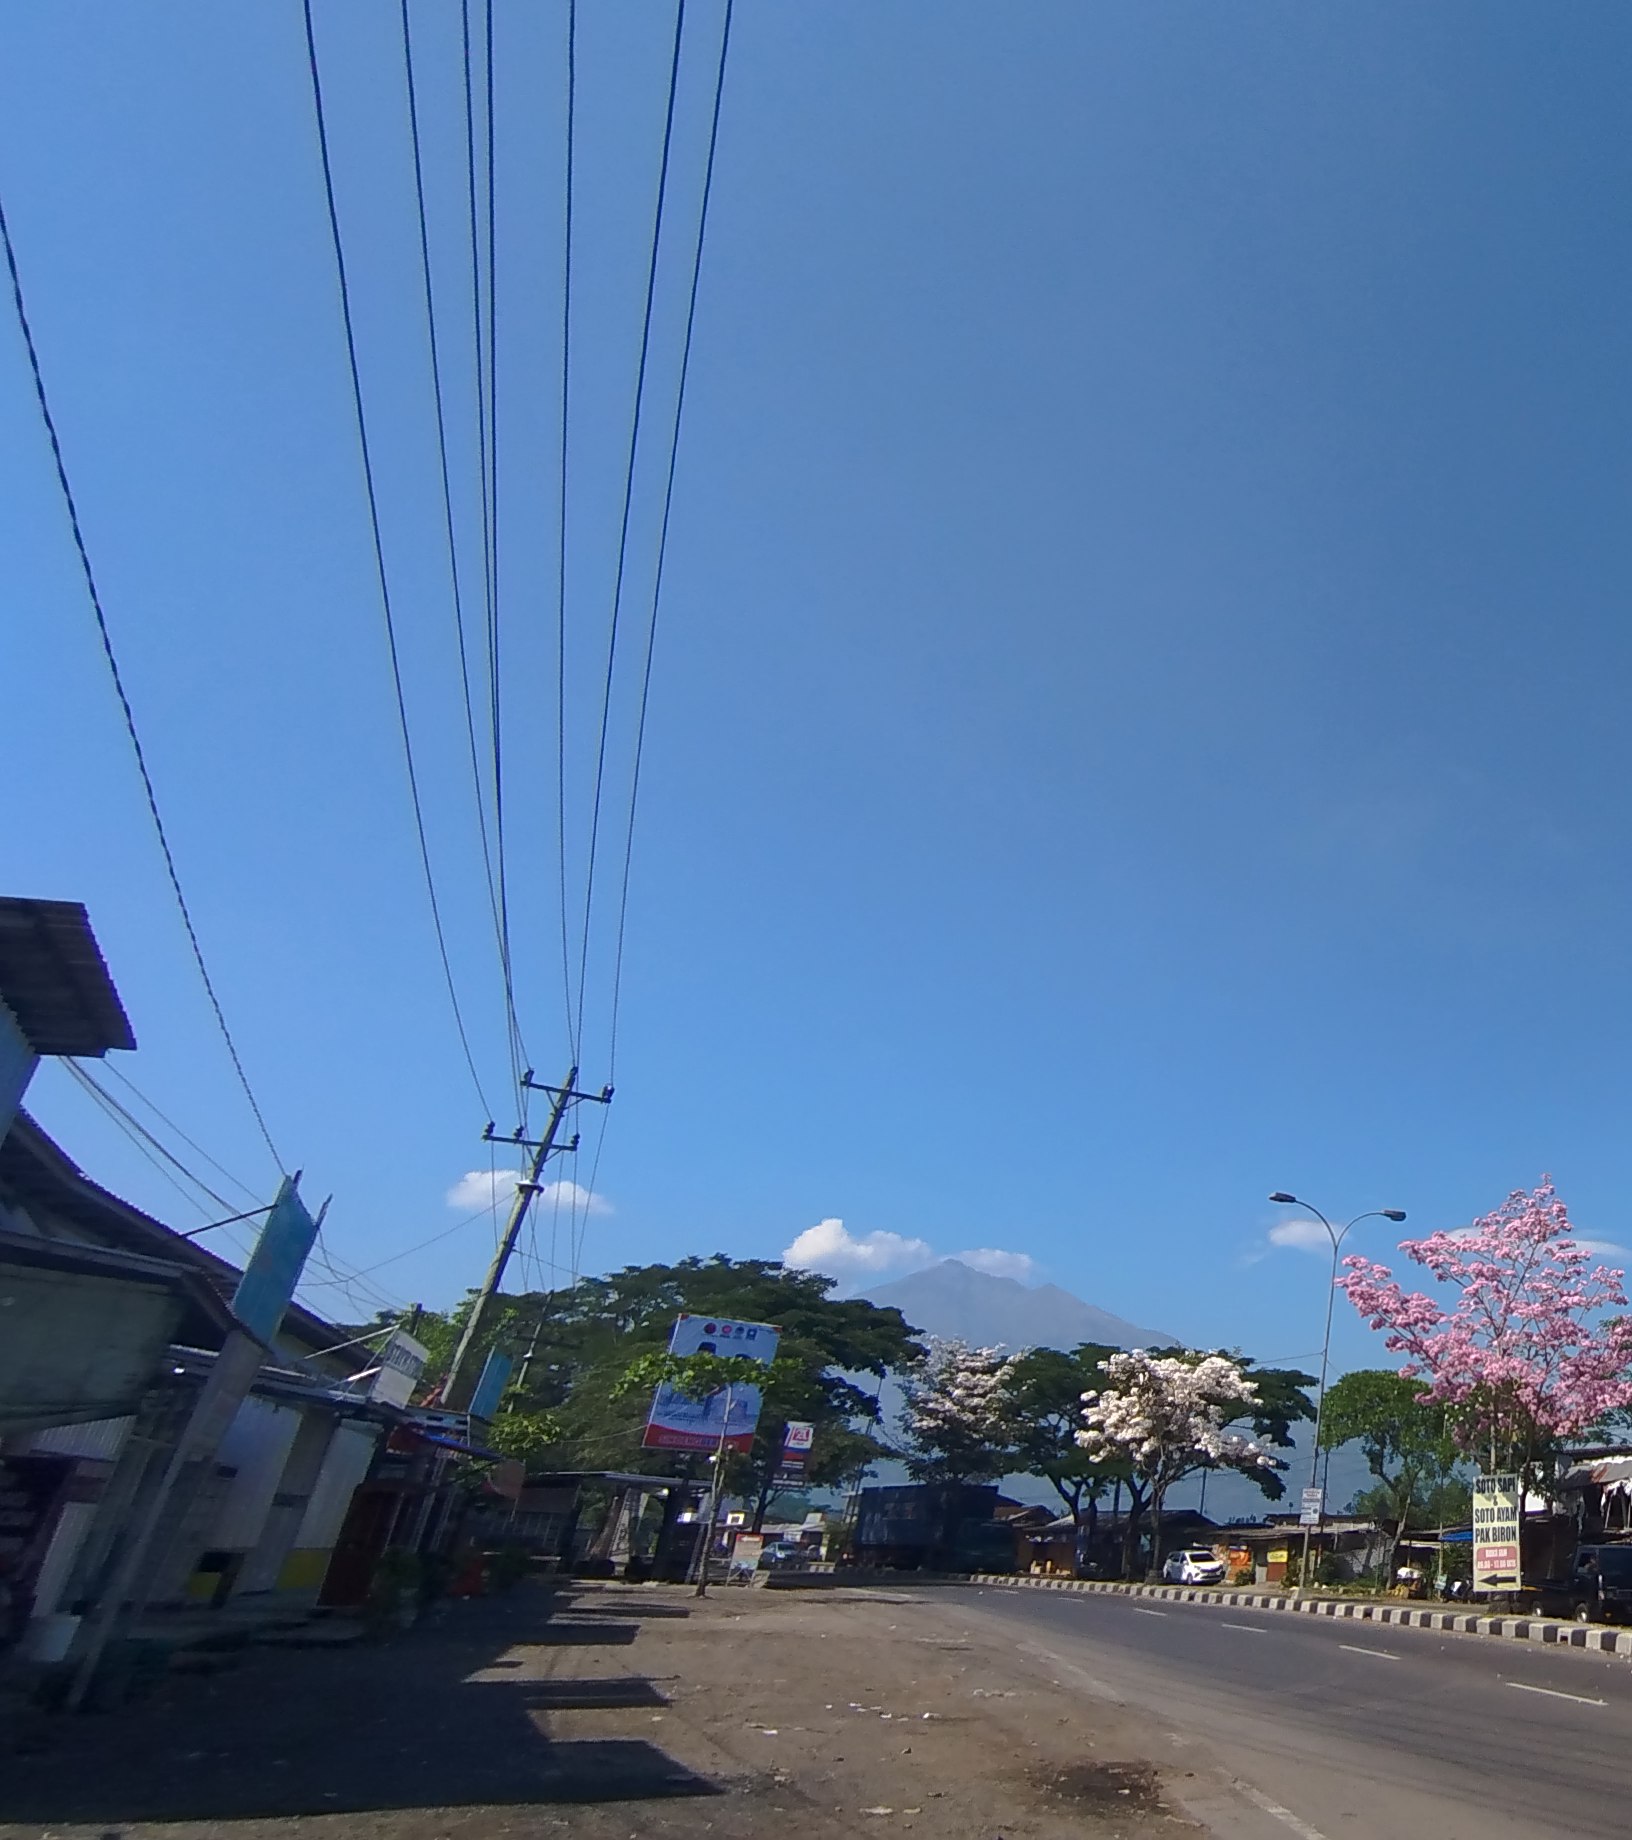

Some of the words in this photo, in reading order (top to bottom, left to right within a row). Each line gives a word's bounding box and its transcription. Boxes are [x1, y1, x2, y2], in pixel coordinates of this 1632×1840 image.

[1476, 1478, 1496, 1494] SOTO
[1498, 1477, 1516, 1493] SAPI
[1475, 1507, 1495, 1523] SOTO
[1497, 1506, 1517, 1522] AYAM
[1475, 1527, 1491, 1543] PAK
[1492, 1525, 1517, 1542] BIRON
